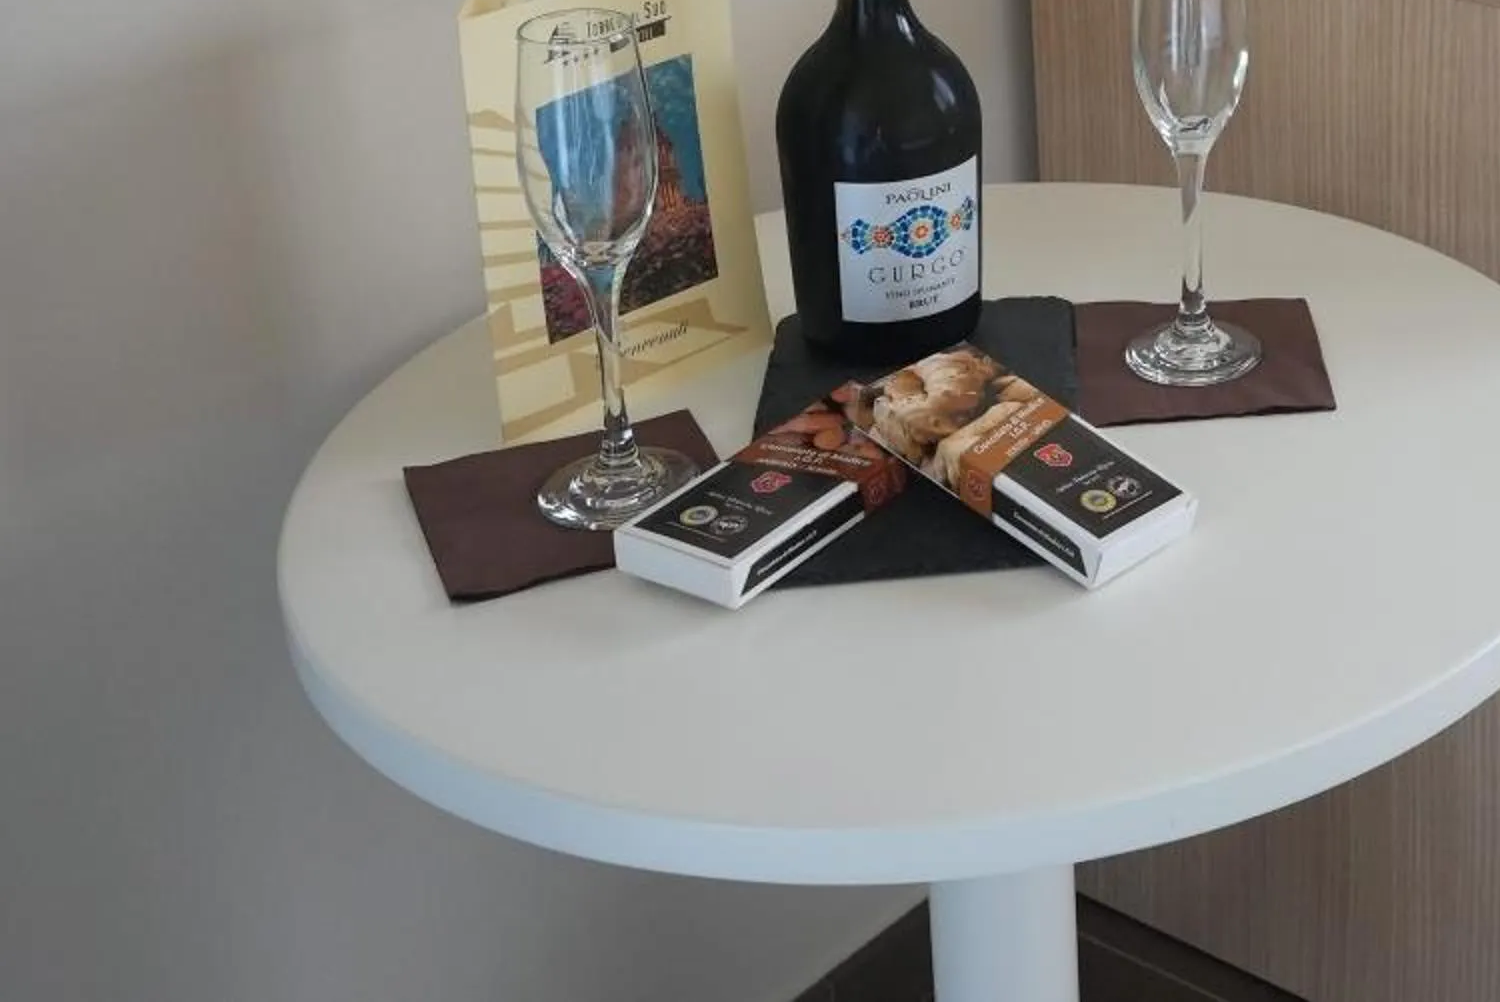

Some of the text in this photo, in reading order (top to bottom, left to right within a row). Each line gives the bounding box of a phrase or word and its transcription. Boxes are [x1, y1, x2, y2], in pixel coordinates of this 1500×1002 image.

[884, 182, 952, 205] PAOLINI
[868, 248, 966, 285] GURGO
[909, 295, 940, 310] BRUT
